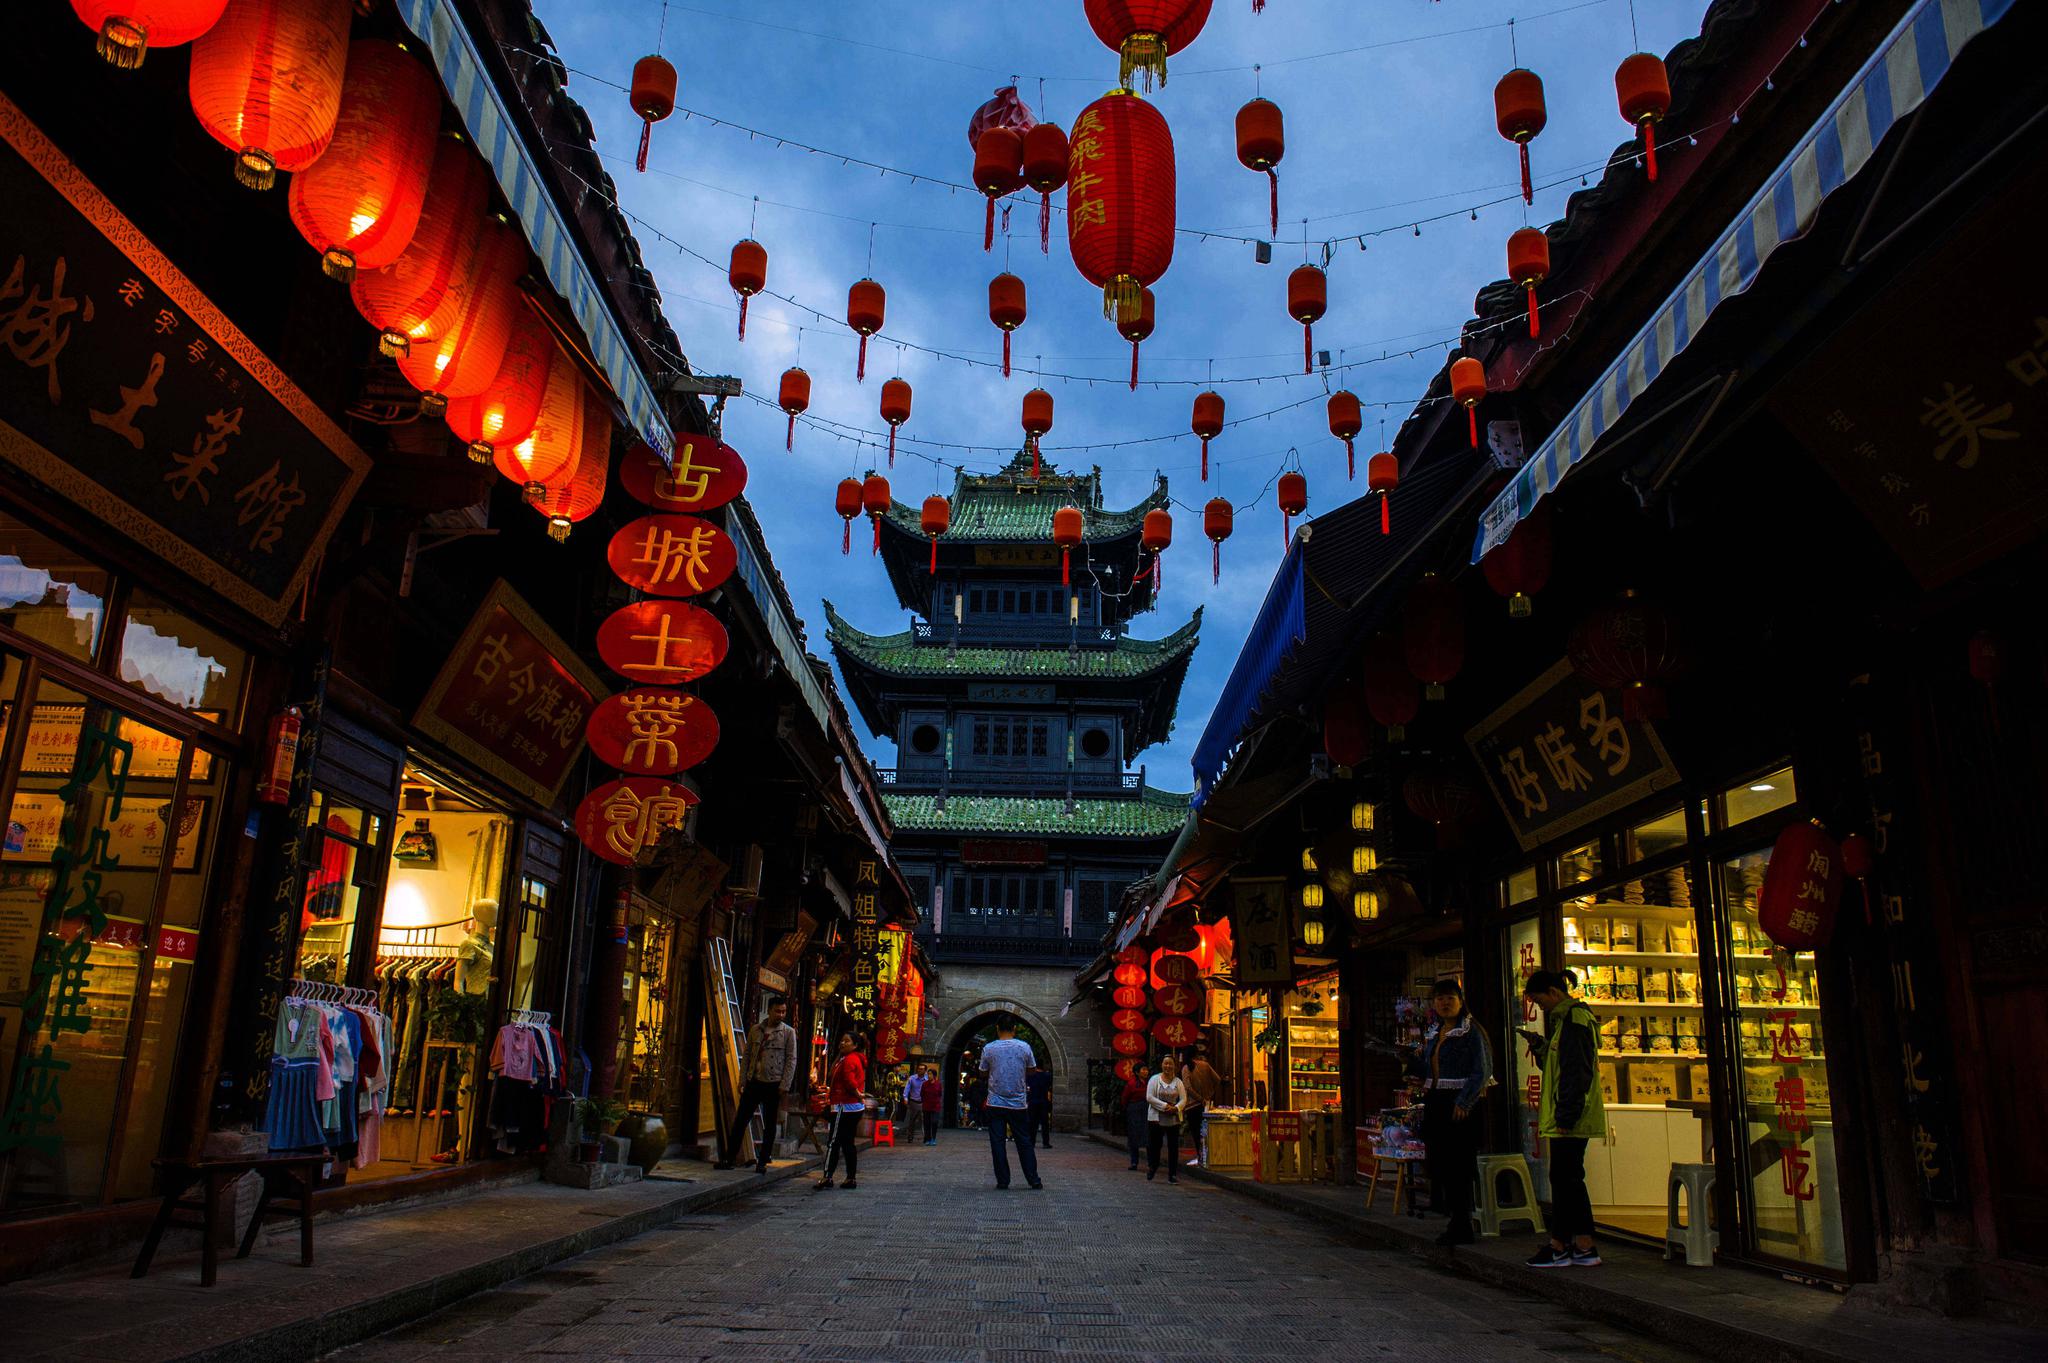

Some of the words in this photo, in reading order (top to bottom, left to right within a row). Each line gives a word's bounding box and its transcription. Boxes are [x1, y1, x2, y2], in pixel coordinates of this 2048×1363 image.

[1499, 690, 1632, 820] 好味多
[1757, 887, 1815, 1202] 了还想吃
